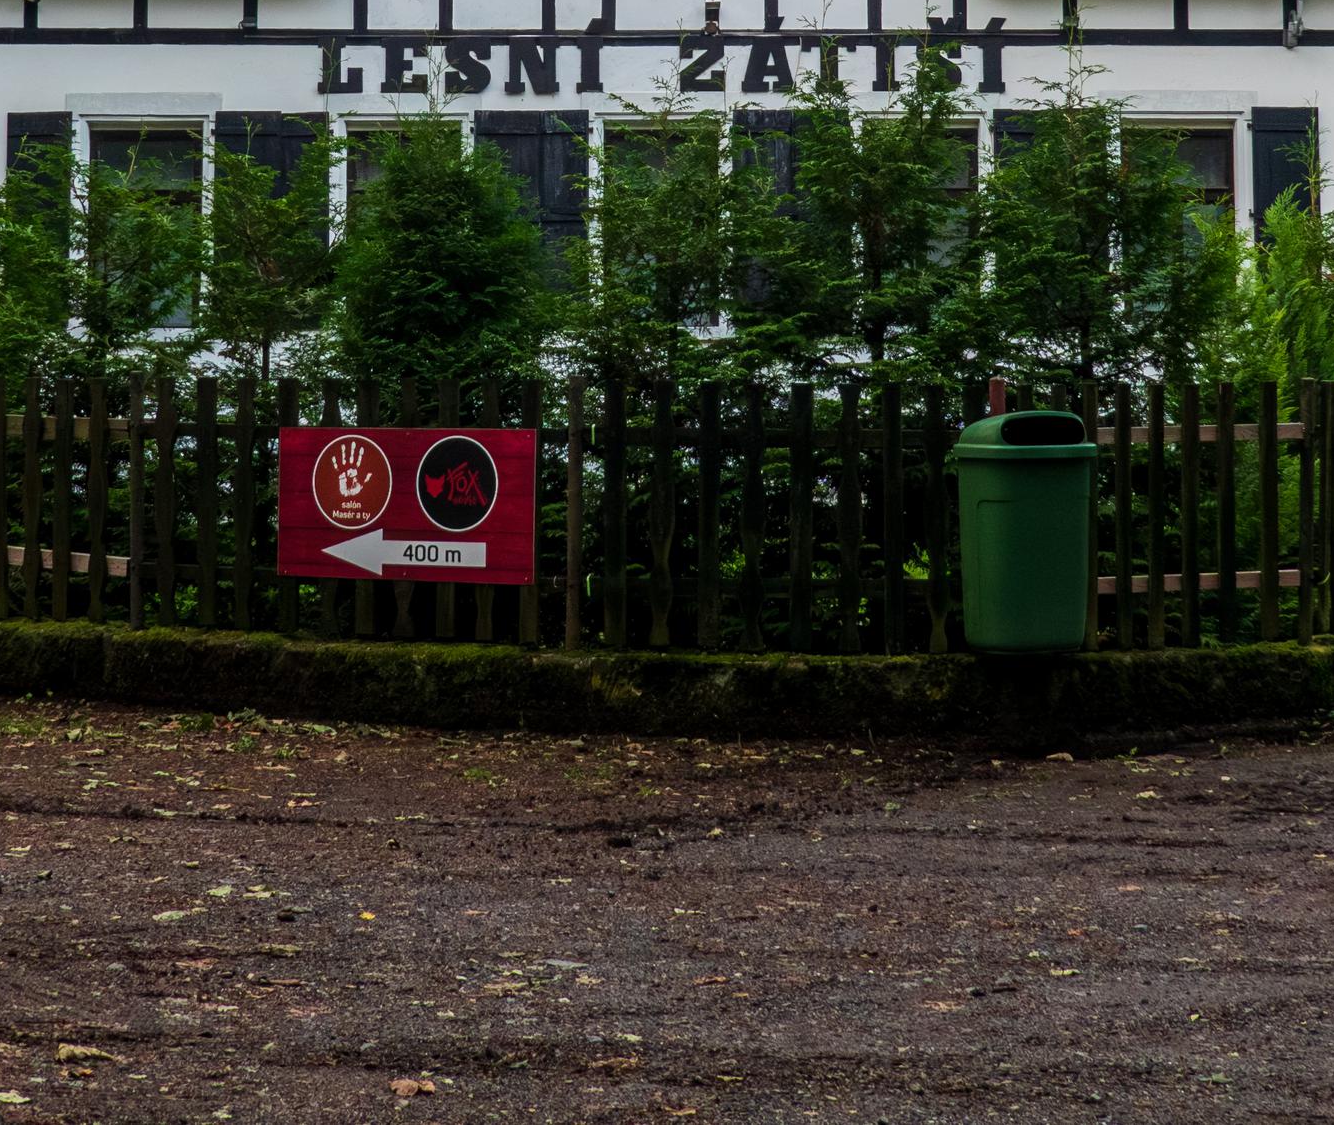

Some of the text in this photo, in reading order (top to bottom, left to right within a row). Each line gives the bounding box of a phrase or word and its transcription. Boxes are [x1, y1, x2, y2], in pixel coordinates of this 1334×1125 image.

[317, 18, 604, 95] LESNÍ
[341, 500, 362, 509] salón
[332, 509, 371, 521] Masér a ty
[403, 544, 462, 563] 400 m
